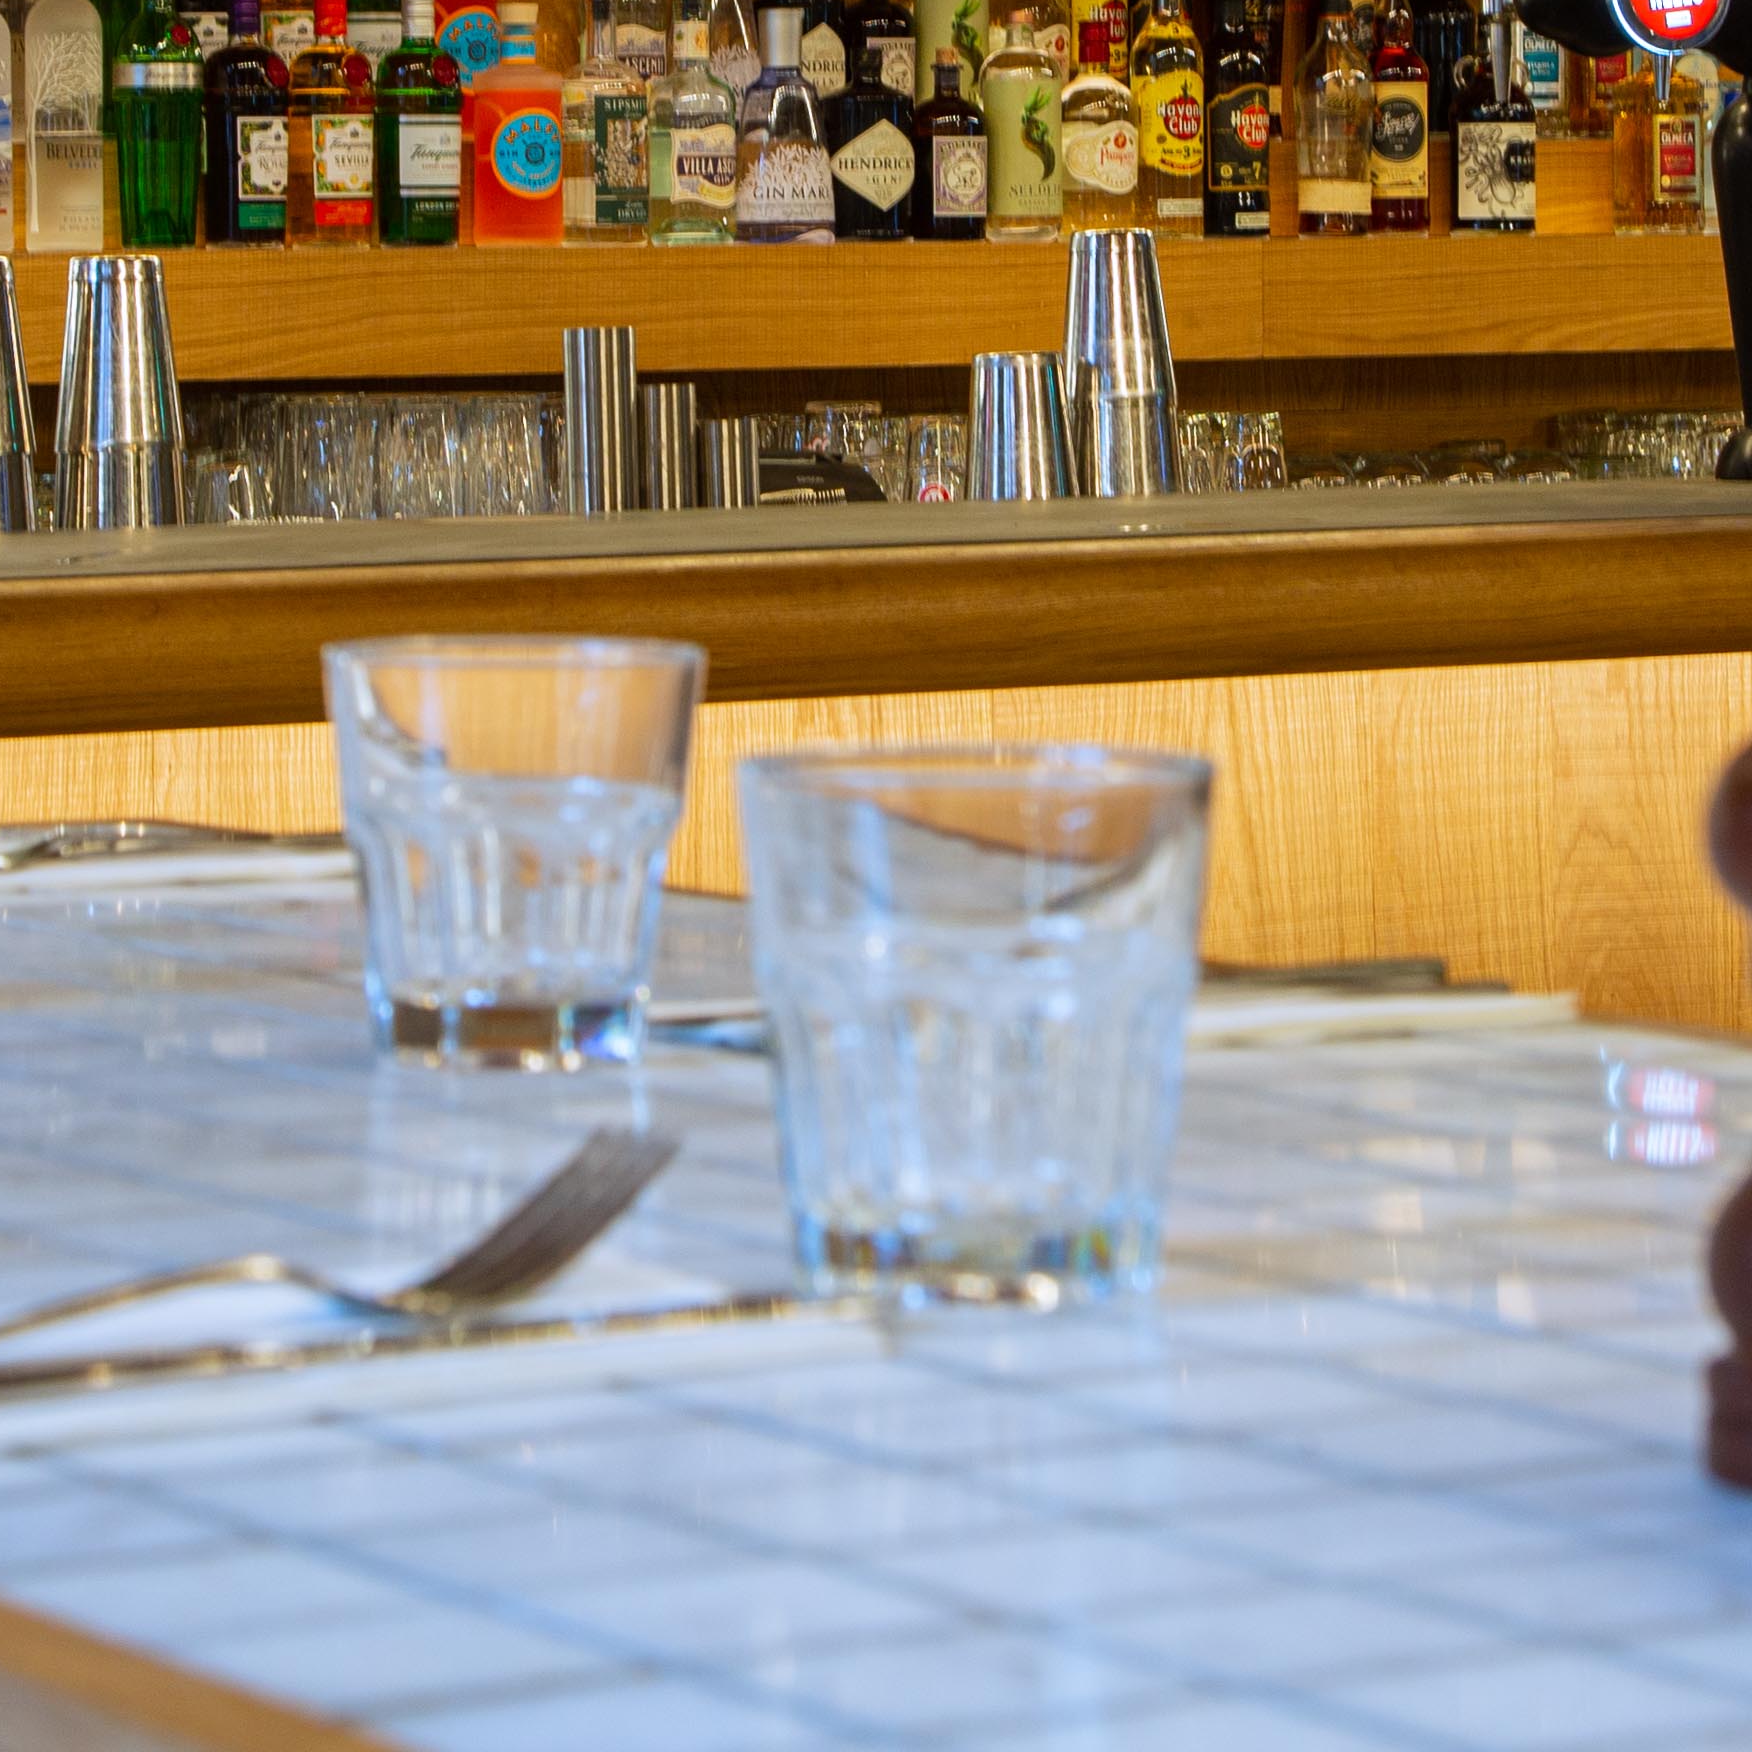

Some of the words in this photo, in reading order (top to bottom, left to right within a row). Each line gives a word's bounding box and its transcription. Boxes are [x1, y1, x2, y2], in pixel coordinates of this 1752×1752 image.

[1109, 21, 1128, 36] lub
[1168, 117, 1199, 135] Club
[1242, 127, 1268, 144] Club
[682, 157, 713, 176] VILLA
[752, 184, 785, 199] GIN
